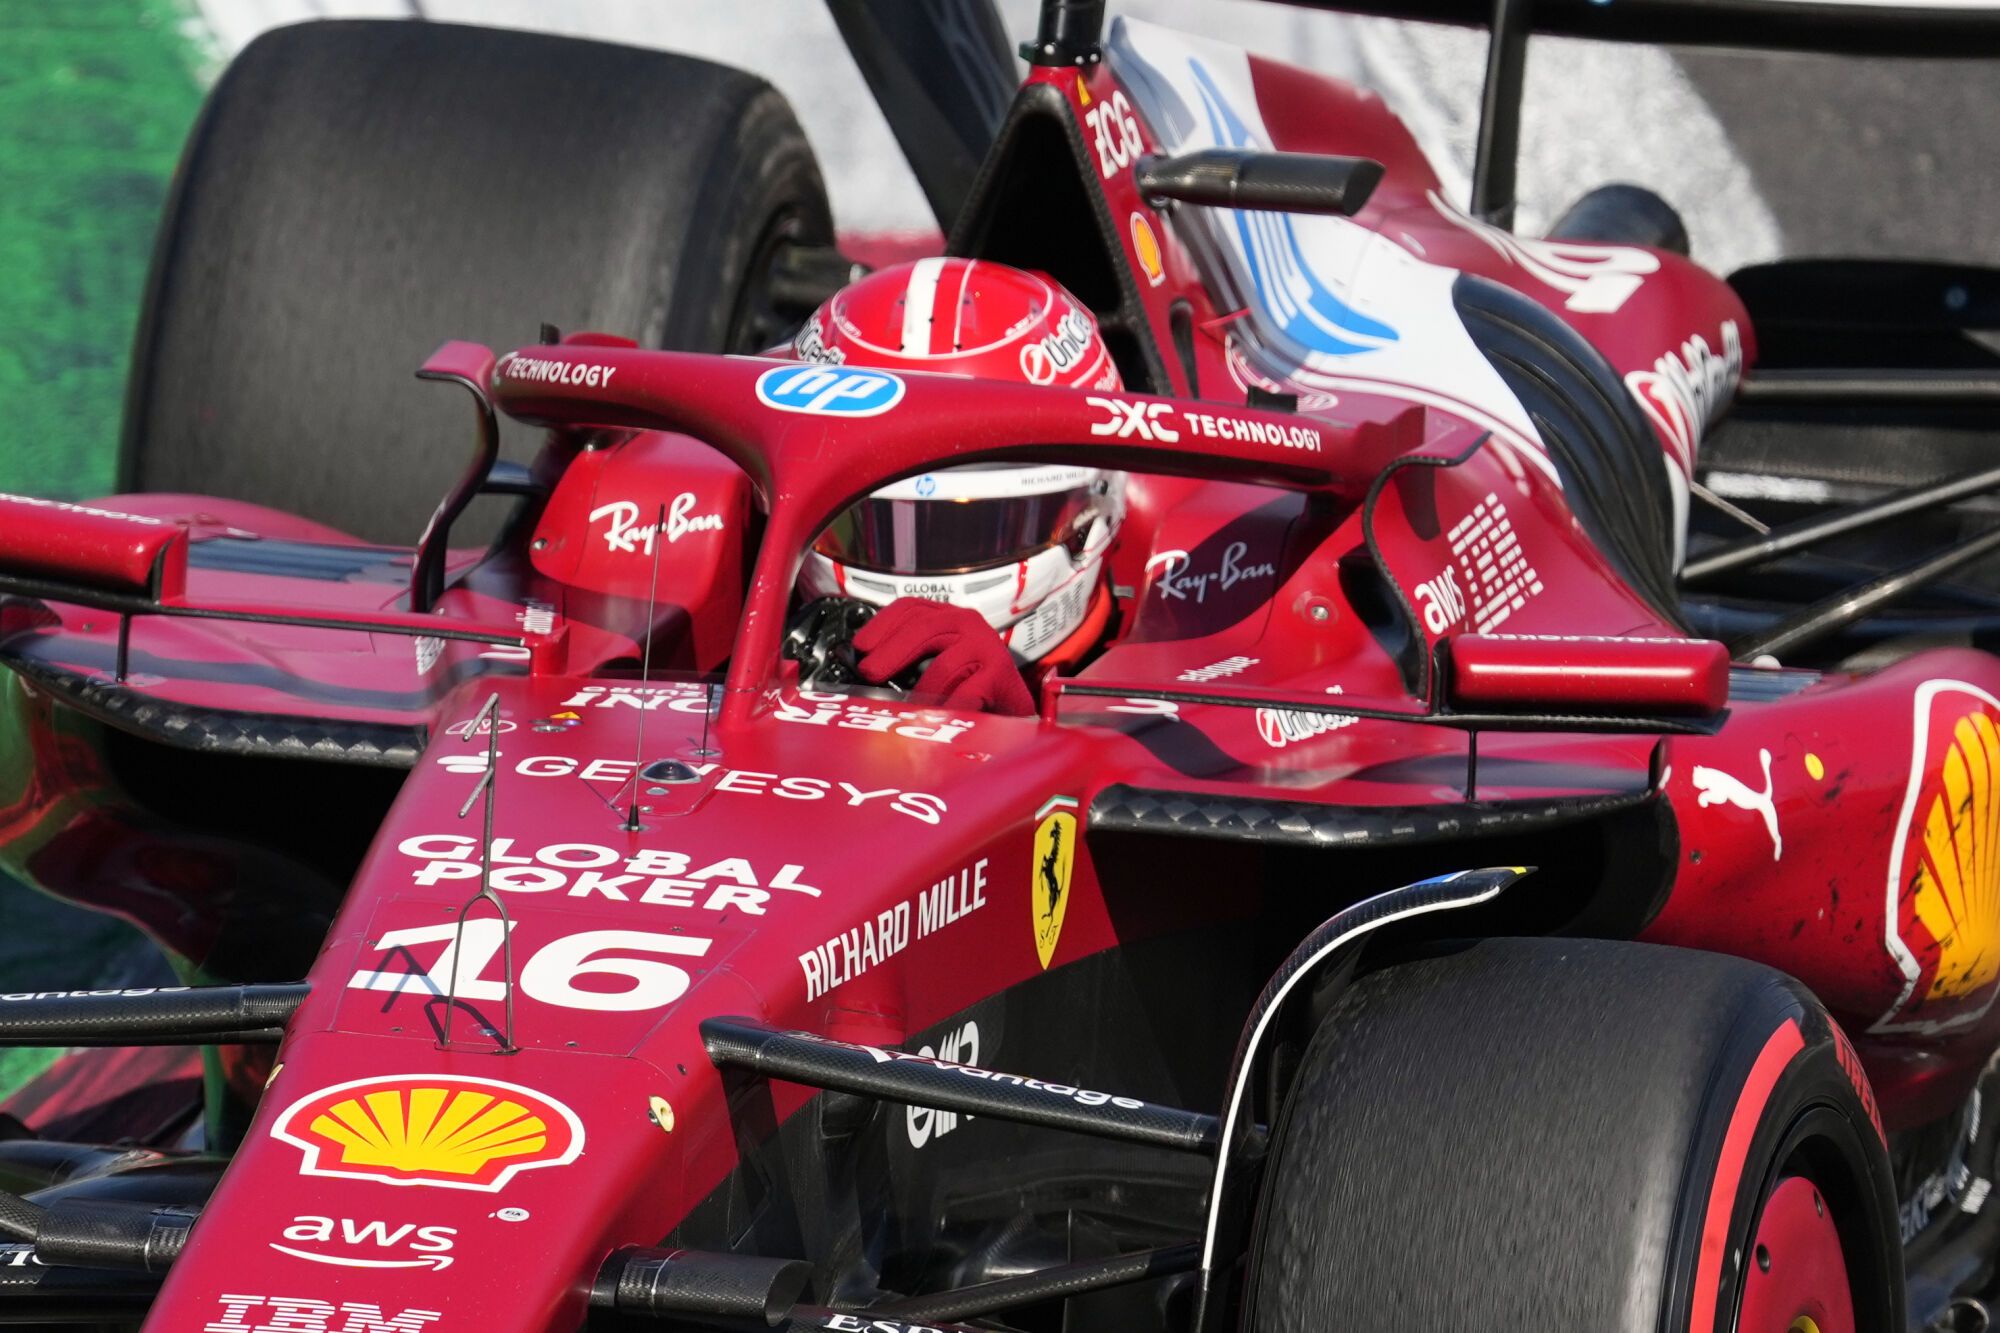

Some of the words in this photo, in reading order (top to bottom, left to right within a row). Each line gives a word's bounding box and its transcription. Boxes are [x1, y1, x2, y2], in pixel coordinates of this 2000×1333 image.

[1085, 90, 1144, 180] ZCG
[505, 357, 617, 388] TECHNOLOGY
[772, 366, 891, 413] hp
[1085, 396, 1179, 443] DXC
[1183, 413, 1322, 452] TECHNOLOGY
[589, 491, 725, 556] Ray-Ban
[904, 583, 955, 594] GLOBAL
[1144, 541, 1276, 604] Ray-Ban
[1413, 564, 1466, 635] aws
[398, 834, 823, 898] GLOBAL
[411, 860, 772, 916] POKER
[798, 900, 911, 1003] RICHARD
[916, 857, 989, 940] MILLE
[347, 917, 713, 1012] 16
[934, 1060, 1145, 1110] vantage
[283, 1215, 458, 1252] aws
[203, 1294, 442, 1333] IBM
